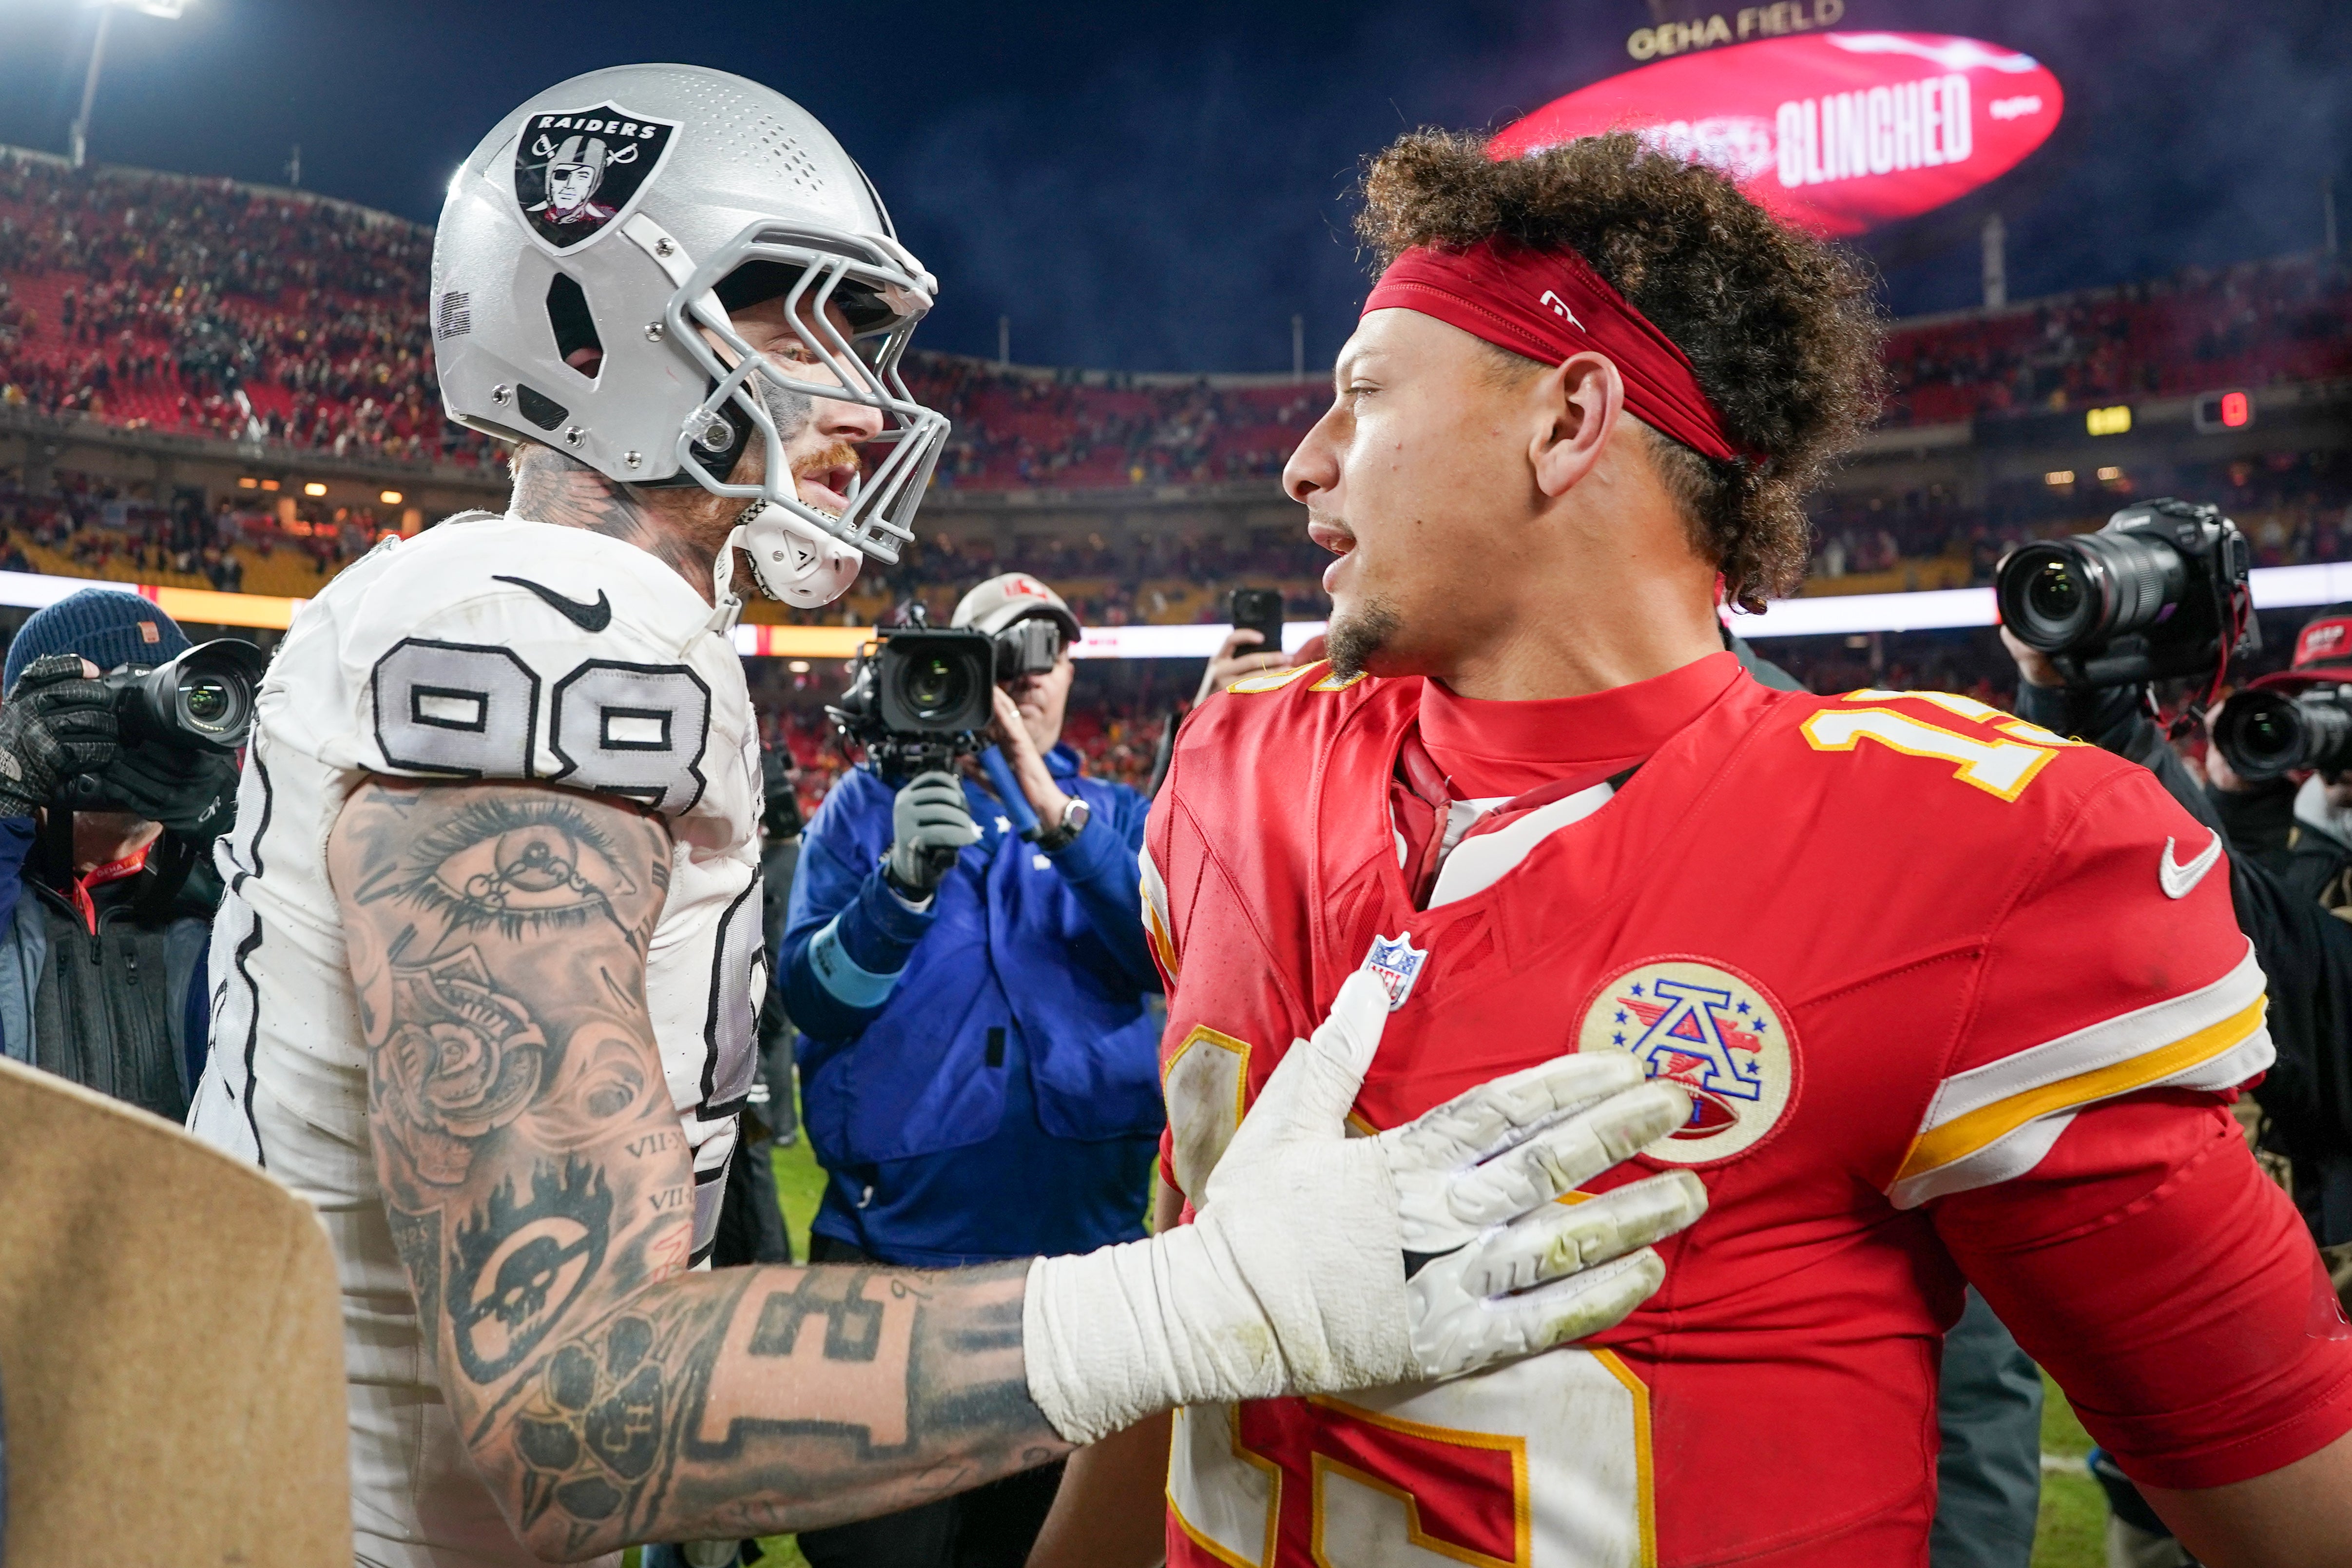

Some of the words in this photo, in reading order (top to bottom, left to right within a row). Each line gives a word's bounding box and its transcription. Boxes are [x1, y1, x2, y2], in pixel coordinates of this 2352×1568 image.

[1737, 0, 1845, 41] FIELD
[538, 116, 657, 139] RAIDERS
[371, 637, 712, 817] 98
[1631, 978, 1761, 1102] A
